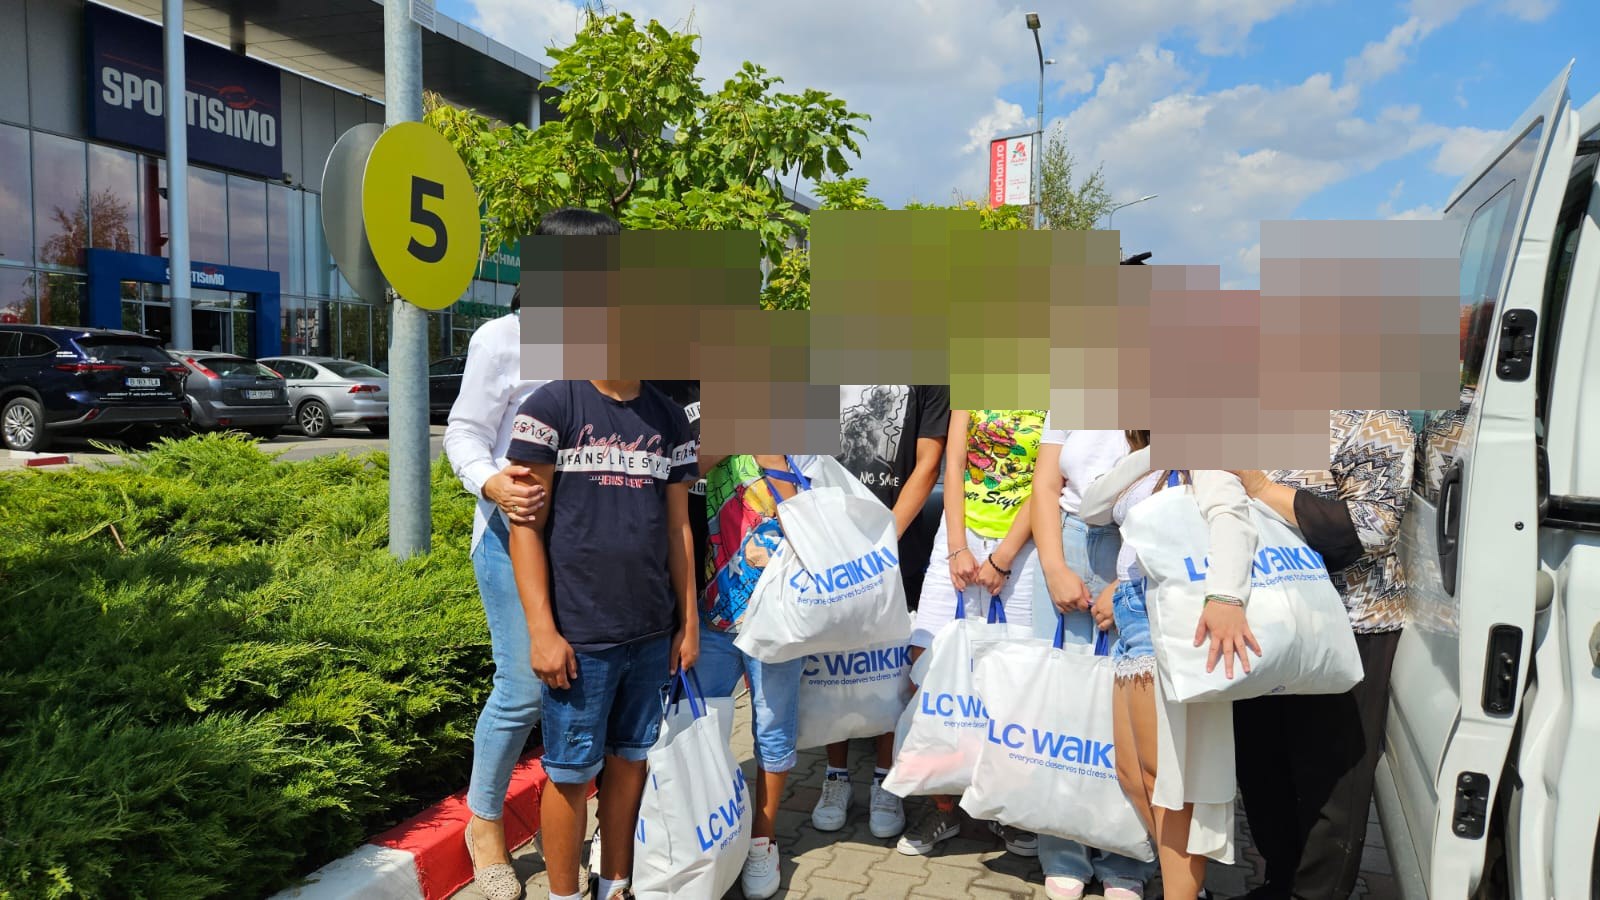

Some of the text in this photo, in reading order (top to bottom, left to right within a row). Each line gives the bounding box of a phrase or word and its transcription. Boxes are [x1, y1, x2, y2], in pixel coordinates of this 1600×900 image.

[102, 66, 276, 147] SPOTISIMO
[994, 144, 1005, 203] auchan.ro
[407, 175, 448, 263] 5
[860, 472, 875, 485] NO
[922, 691, 953, 717] LC
[988, 719, 1026, 749] LC
[696, 812, 723, 852] LC
